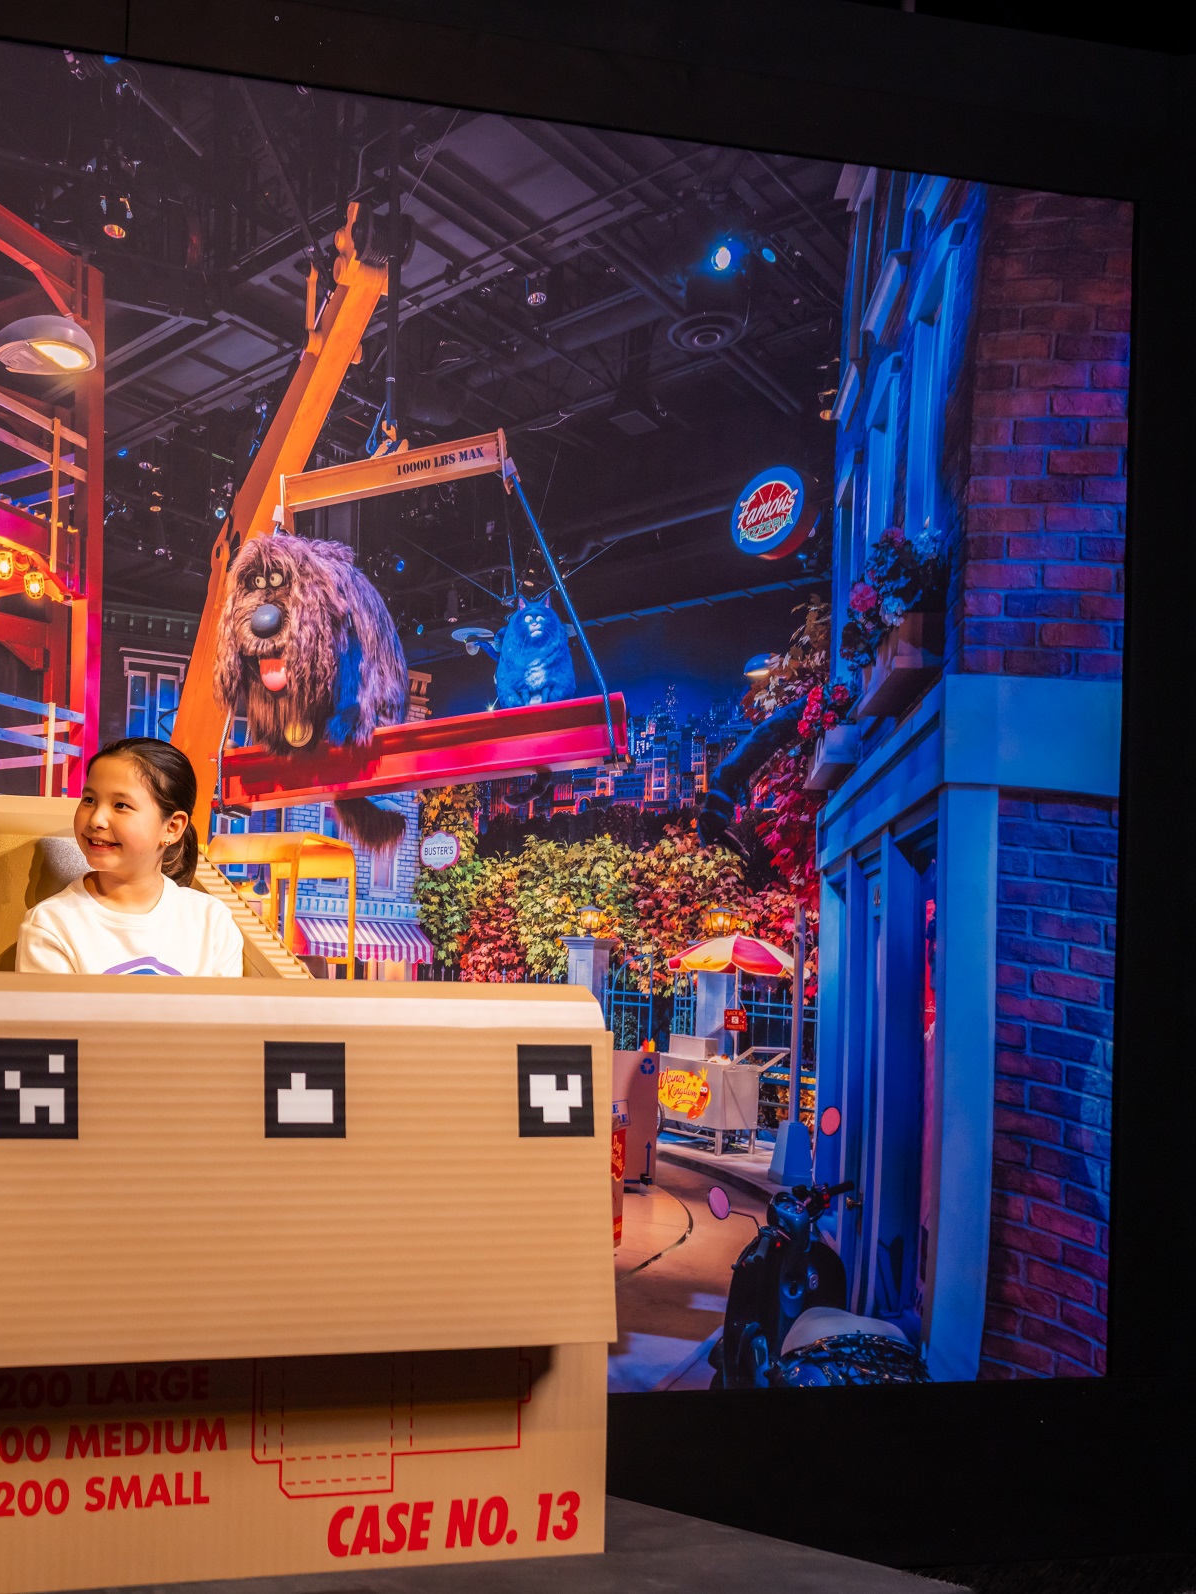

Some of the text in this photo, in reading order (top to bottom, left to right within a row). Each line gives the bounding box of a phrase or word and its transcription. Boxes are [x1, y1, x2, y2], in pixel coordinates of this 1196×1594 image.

[737, 489, 798, 529] Famous
[739, 513, 793, 543] PIZZERIA
[424, 846, 454, 856] BUSTER'S
[86, 1367, 210, 1405] LARGE
[65, 1417, 228, 1460] MEDIUM
[84, 1471, 210, 1512] SMALL
[327, 1491, 581, 1557] CASE NO. 13
